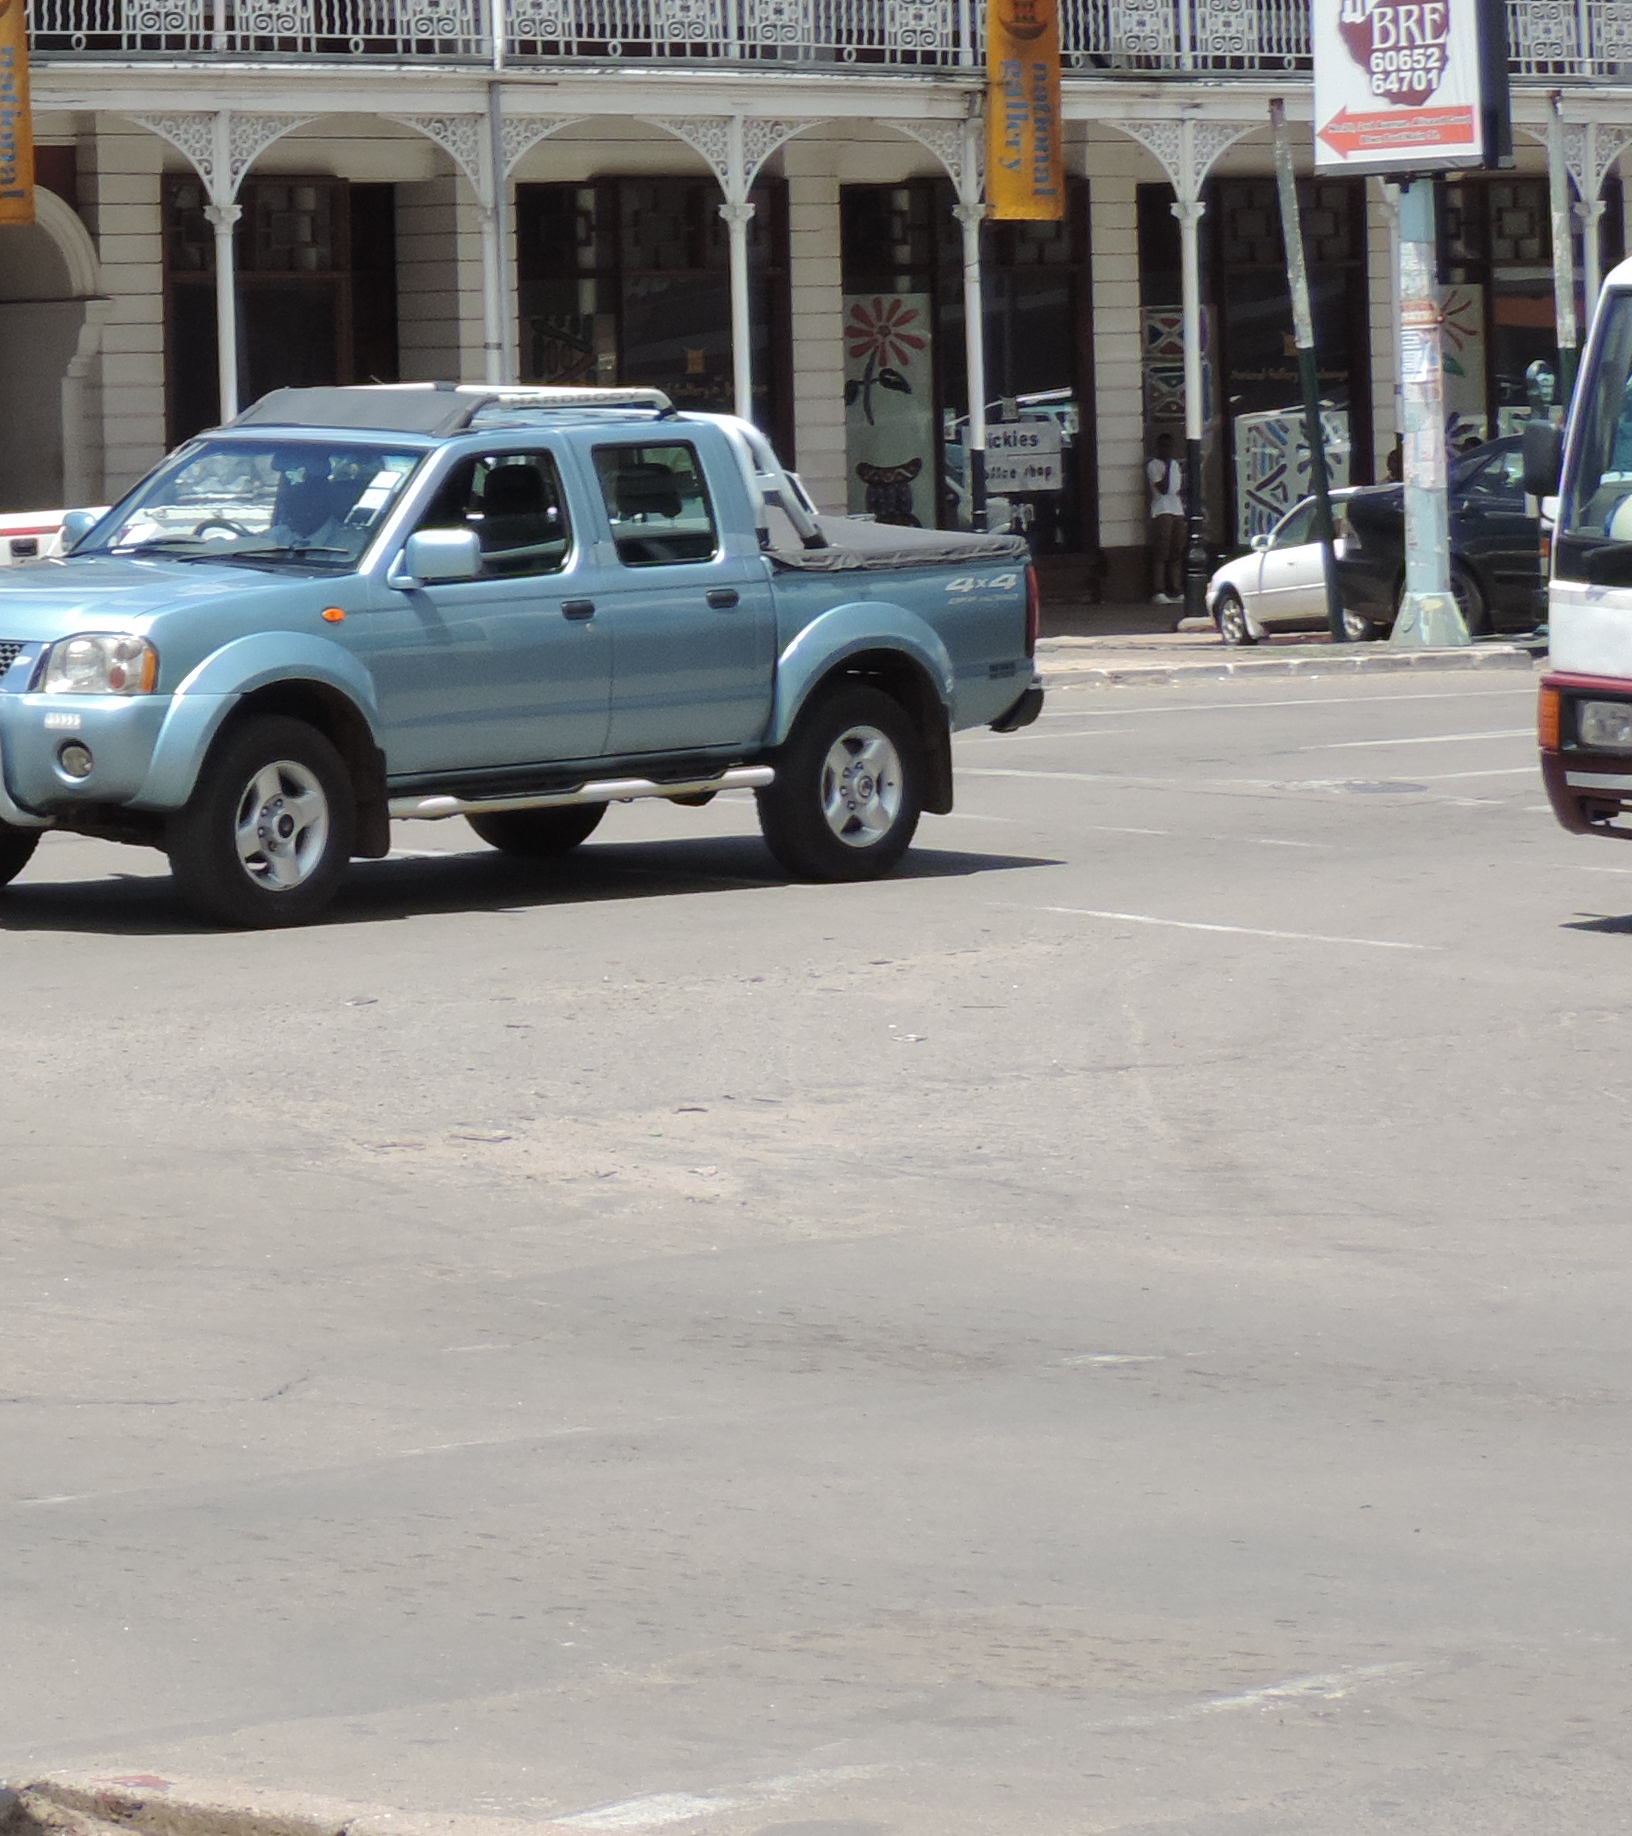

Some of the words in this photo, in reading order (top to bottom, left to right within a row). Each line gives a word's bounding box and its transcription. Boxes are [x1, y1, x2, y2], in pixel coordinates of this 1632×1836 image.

[1370, 2, 1447, 50] BRE
[1370, 47, 1442, 73] 60652
[1372, 68, 1439, 94] 64701
[999, 59, 1030, 171] gallery
[945, 573, 1018, 593] 4x4
